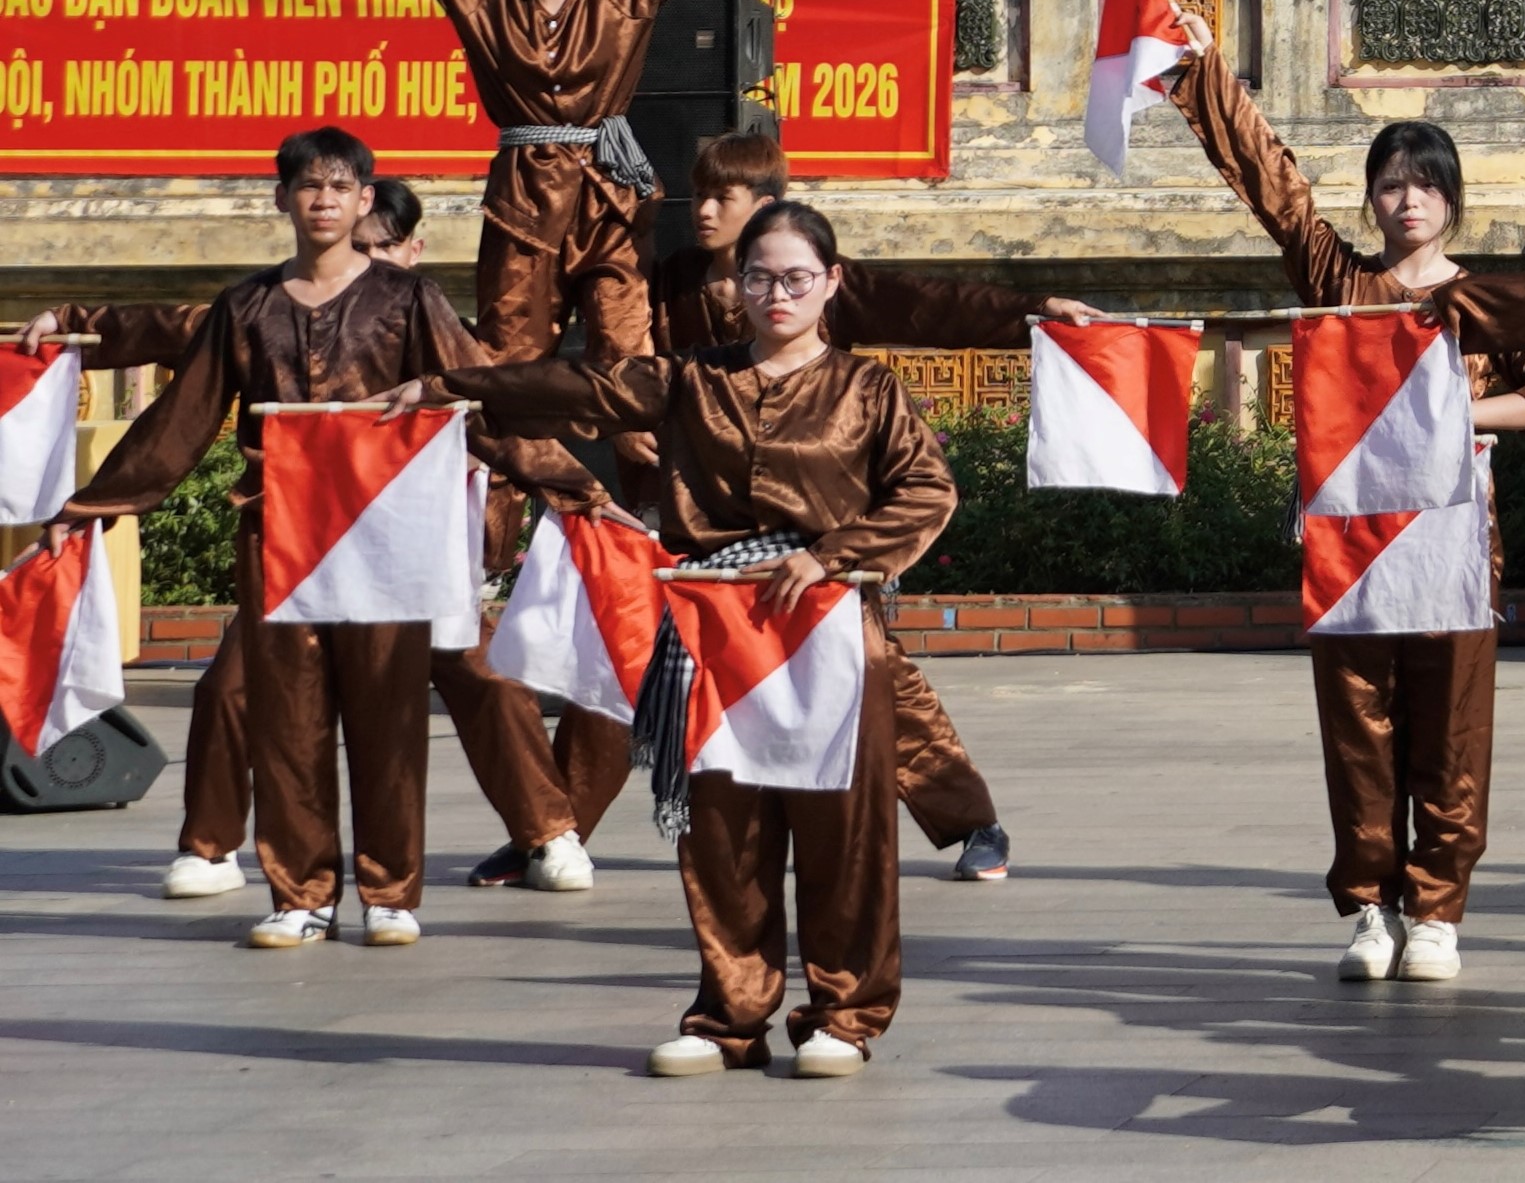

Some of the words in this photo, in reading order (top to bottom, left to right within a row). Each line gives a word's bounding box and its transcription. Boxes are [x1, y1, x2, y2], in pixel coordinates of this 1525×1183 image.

[0, 47, 54, 129] ỘI,
[64, 47, 174, 118] NHÓM
[185, 48, 304, 117] THÀNH
[312, 40, 389, 118] PHỐ
[811, 62, 900, 119] 2026
